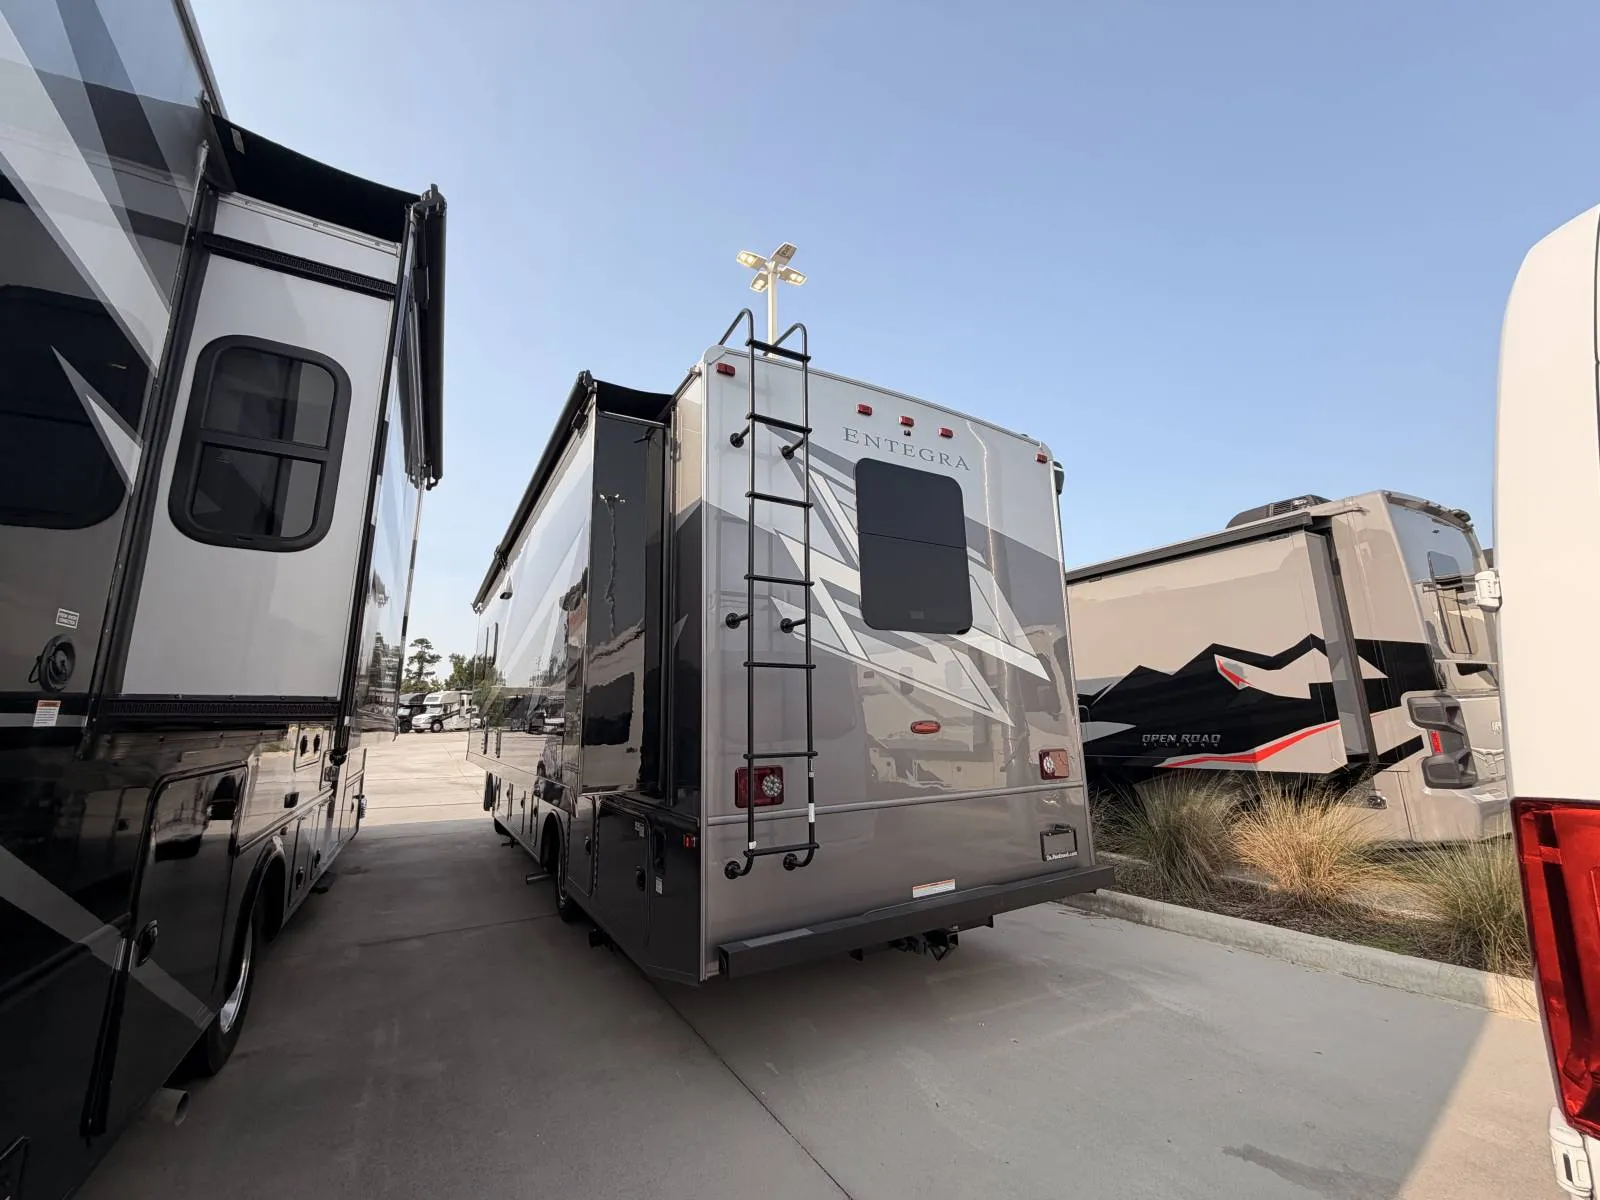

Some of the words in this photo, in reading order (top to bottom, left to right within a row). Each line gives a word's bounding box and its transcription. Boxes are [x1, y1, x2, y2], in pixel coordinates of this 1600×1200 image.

[843, 427, 970, 471] ENTEGRA
[1142, 734, 1177, 743] OPEN
[1181, 734, 1221, 743] ROAD
